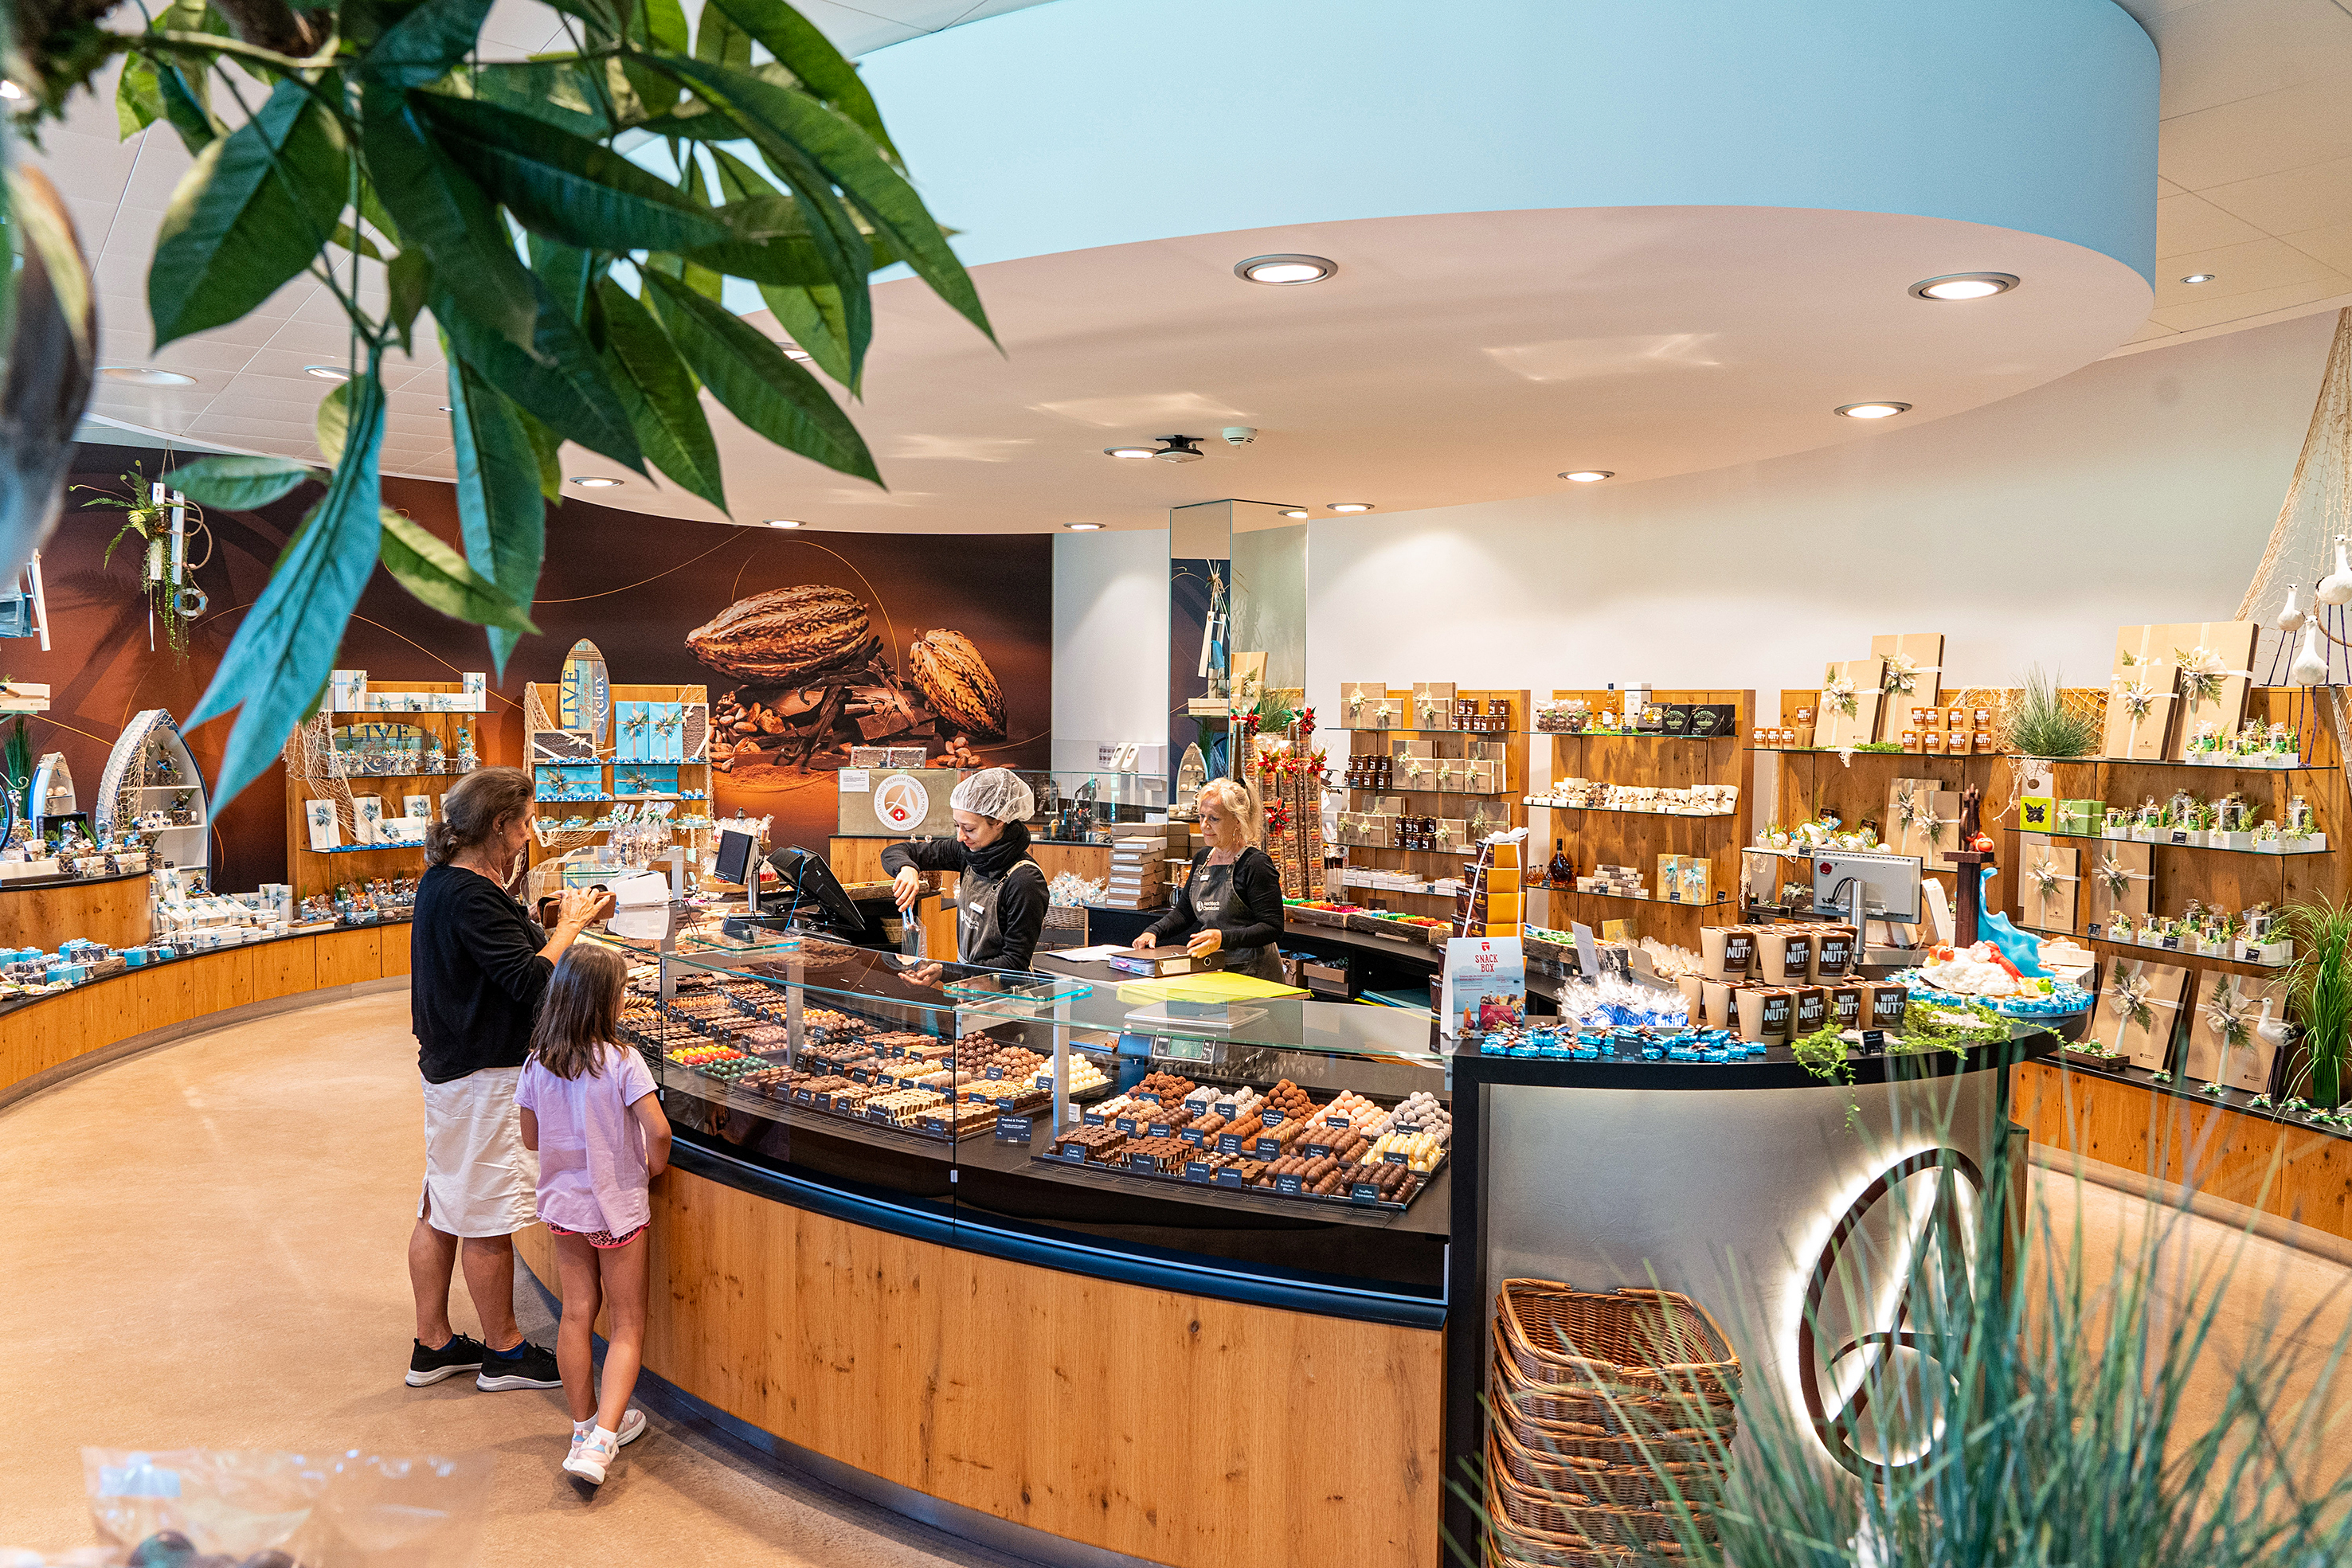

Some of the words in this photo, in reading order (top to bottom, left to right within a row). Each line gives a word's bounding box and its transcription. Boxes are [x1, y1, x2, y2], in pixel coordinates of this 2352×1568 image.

[563, 670, 579, 729] LIVE
[578, 683, 591, 717] Love
[593, 675, 609, 727] Relax
[347, 725, 412, 742] LIVE
[886, 777, 906, 786] PREMIUM
[906, 779, 925, 800] CHOCOLATE
[1726, 946, 1751, 958] NUT?
[1791, 942, 1806, 951] WHY
[1475, 954, 1498, 963] SNACK
[1786, 949, 1810, 964] NUT?
[1821, 950, 1848, 962] NUT?
[1481, 964, 1494, 972] BOX
[1770, 999, 1785, 1008] WHY
[1803, 997, 1819, 1007] WHY
[1838, 995, 1854, 1003] WHY
[1764, 1007, 1790, 1021] NUT?
[1799, 1003, 1824, 1019] NUT?
[1874, 1001, 1904, 1014] NUT?
